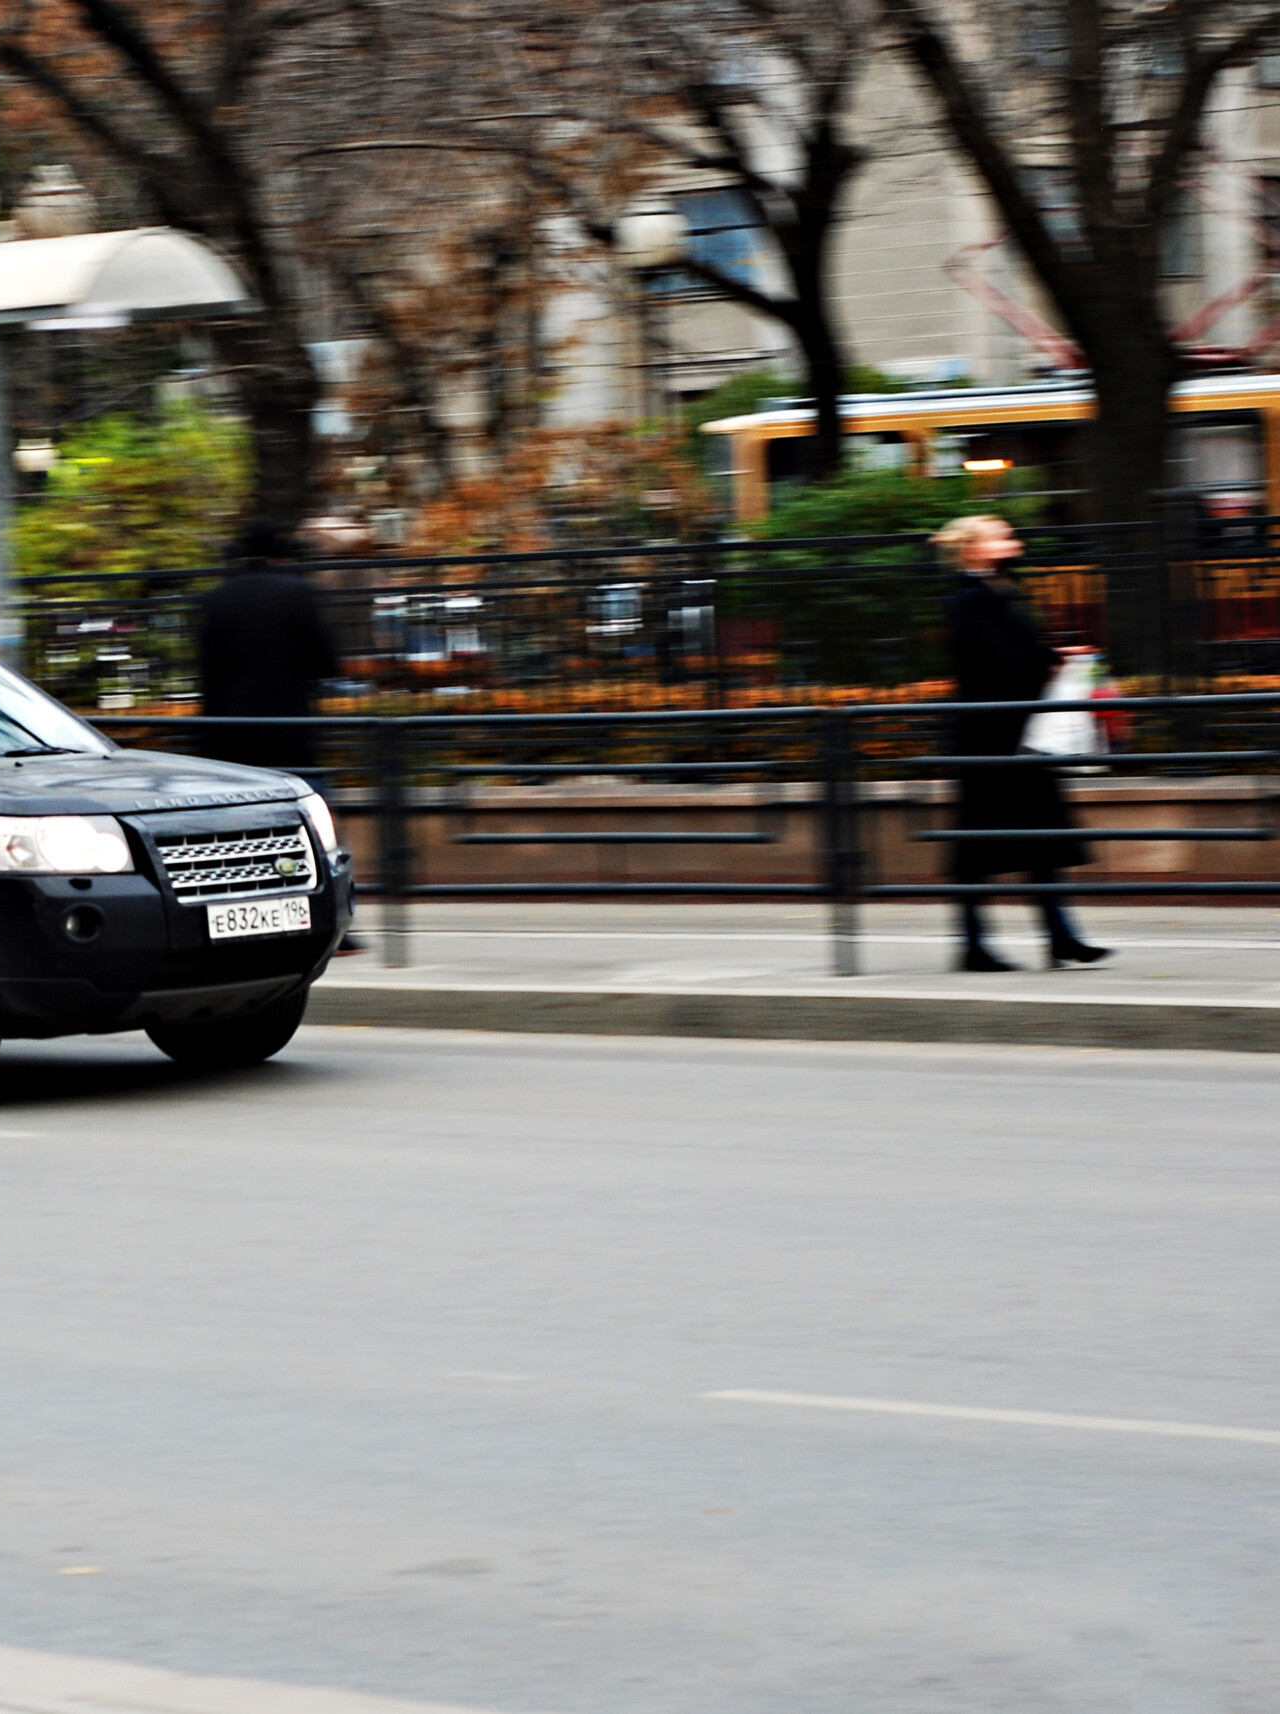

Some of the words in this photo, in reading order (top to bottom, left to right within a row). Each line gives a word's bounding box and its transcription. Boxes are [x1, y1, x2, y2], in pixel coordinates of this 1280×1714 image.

[135, 796, 199, 810] LAND
[209, 790, 278, 803] ROVER
[285, 901, 308, 917] 196
